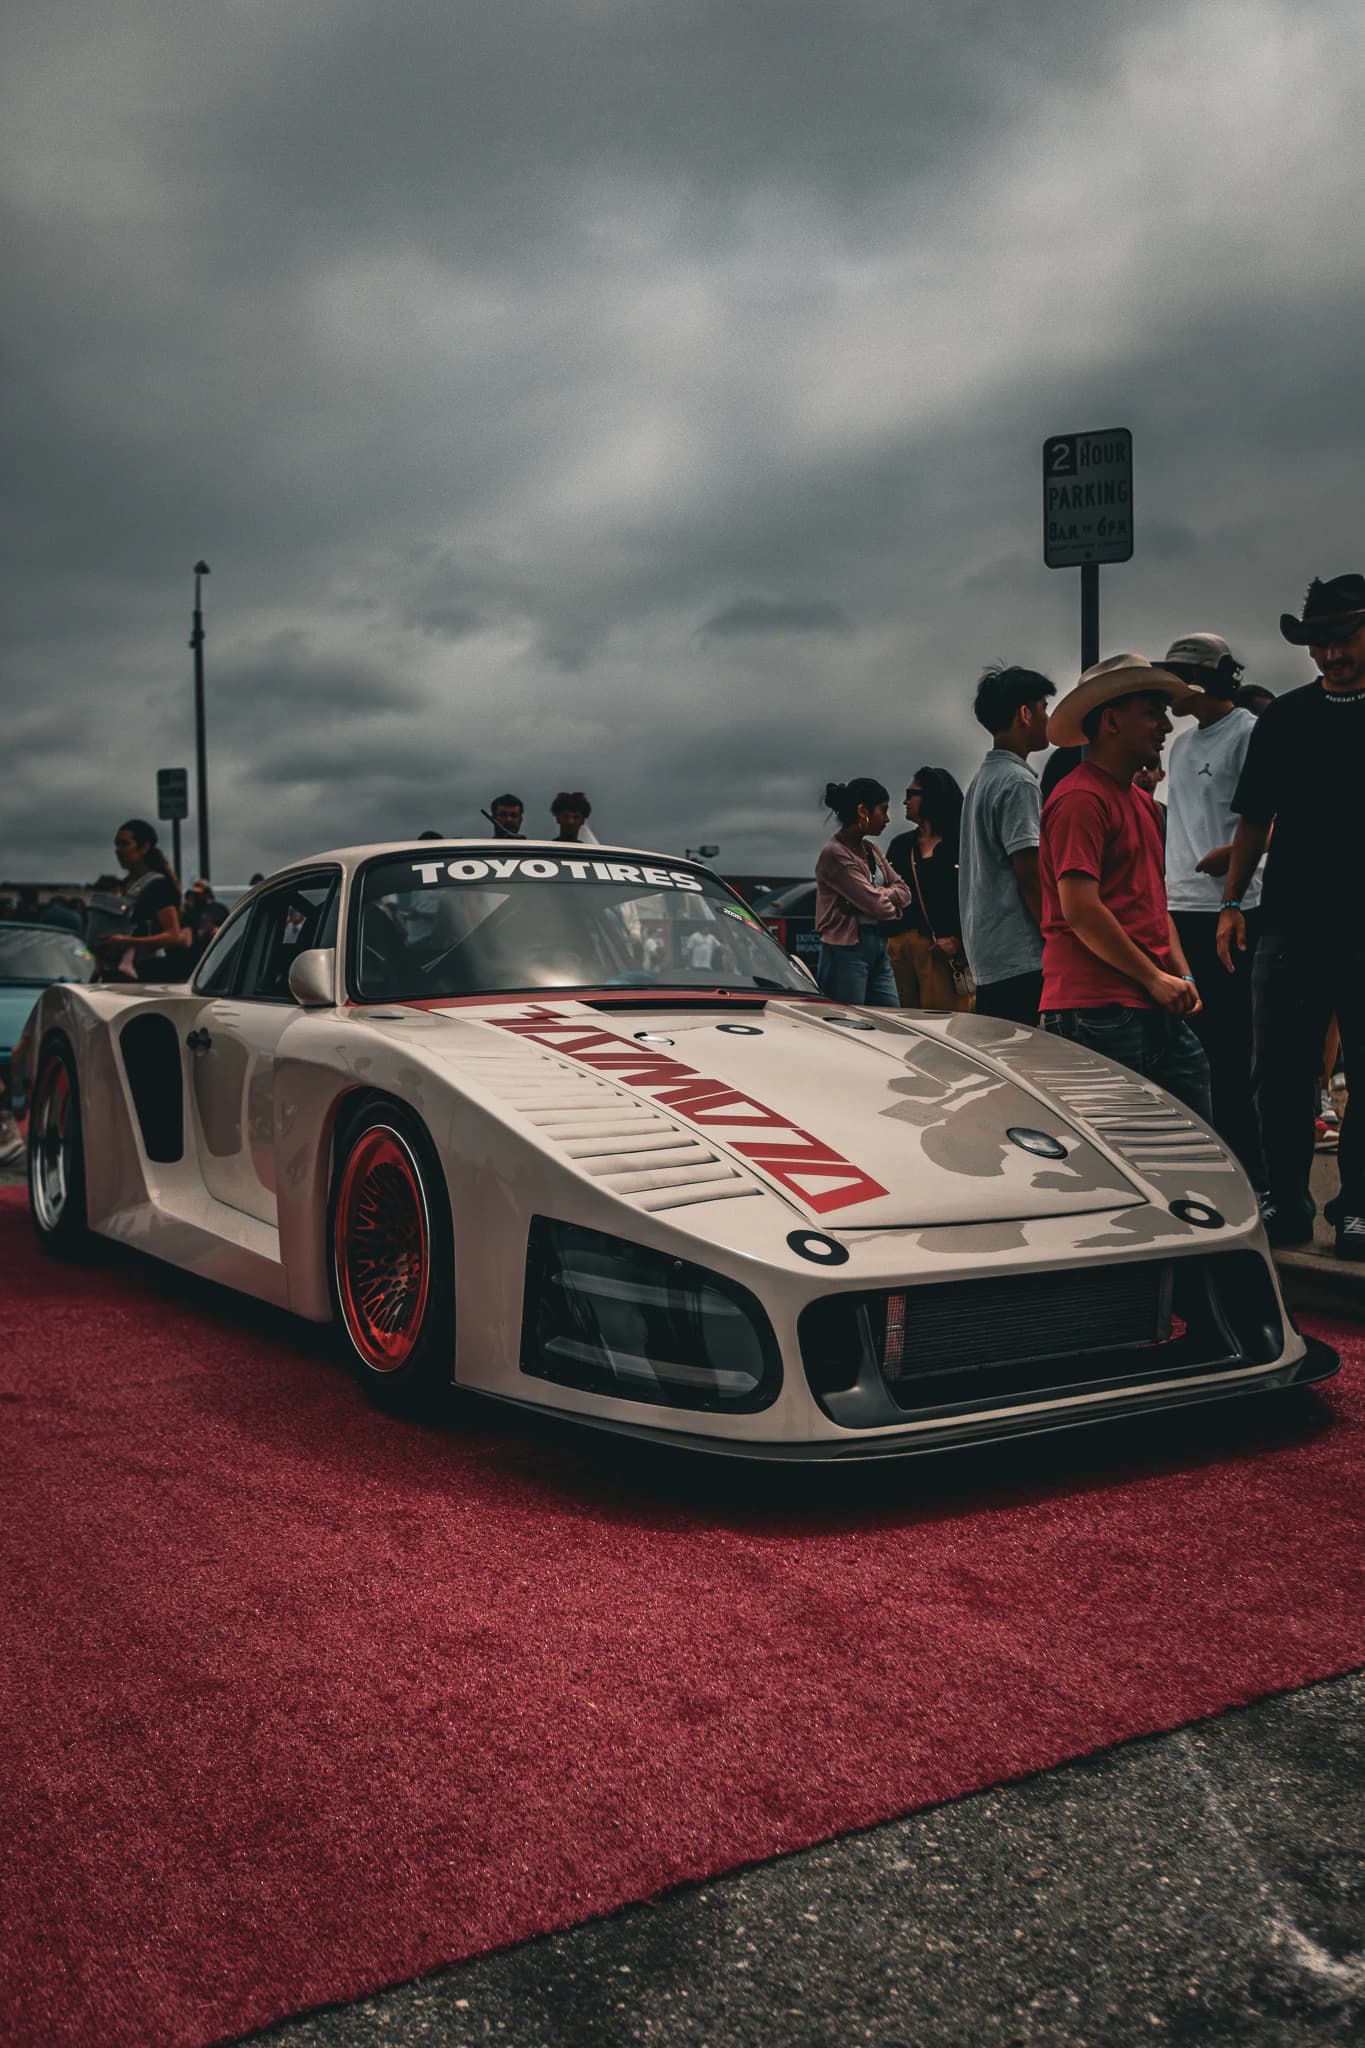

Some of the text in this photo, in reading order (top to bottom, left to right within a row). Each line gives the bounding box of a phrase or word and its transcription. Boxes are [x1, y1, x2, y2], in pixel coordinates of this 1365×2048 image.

[1052, 439, 1127, 472] 2 HOUR
[1049, 480, 1129, 511] PARKING
